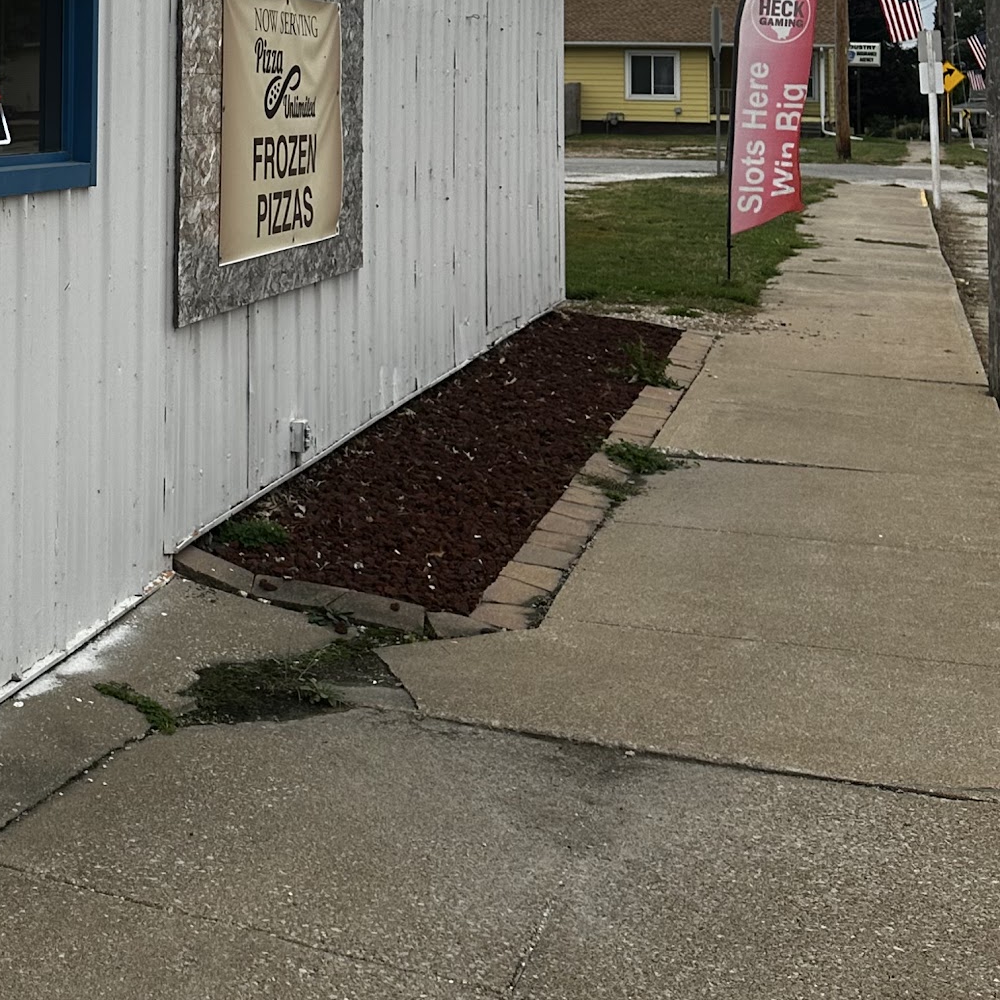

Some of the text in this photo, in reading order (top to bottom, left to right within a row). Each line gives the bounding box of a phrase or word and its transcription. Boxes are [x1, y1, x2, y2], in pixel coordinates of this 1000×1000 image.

[254, 7, 318, 38] NOW SERVING
[758, 16, 804, 28] GAMING
[254, 36, 284, 75] Pizza
[283, 94, 317, 119] Unlimited
[252, 133, 317, 182] FROZEN
[736, 61, 770, 214] Slots Here
[770, 83, 808, 197] Win Big
[256, 185, 314, 239] PIZZAS
